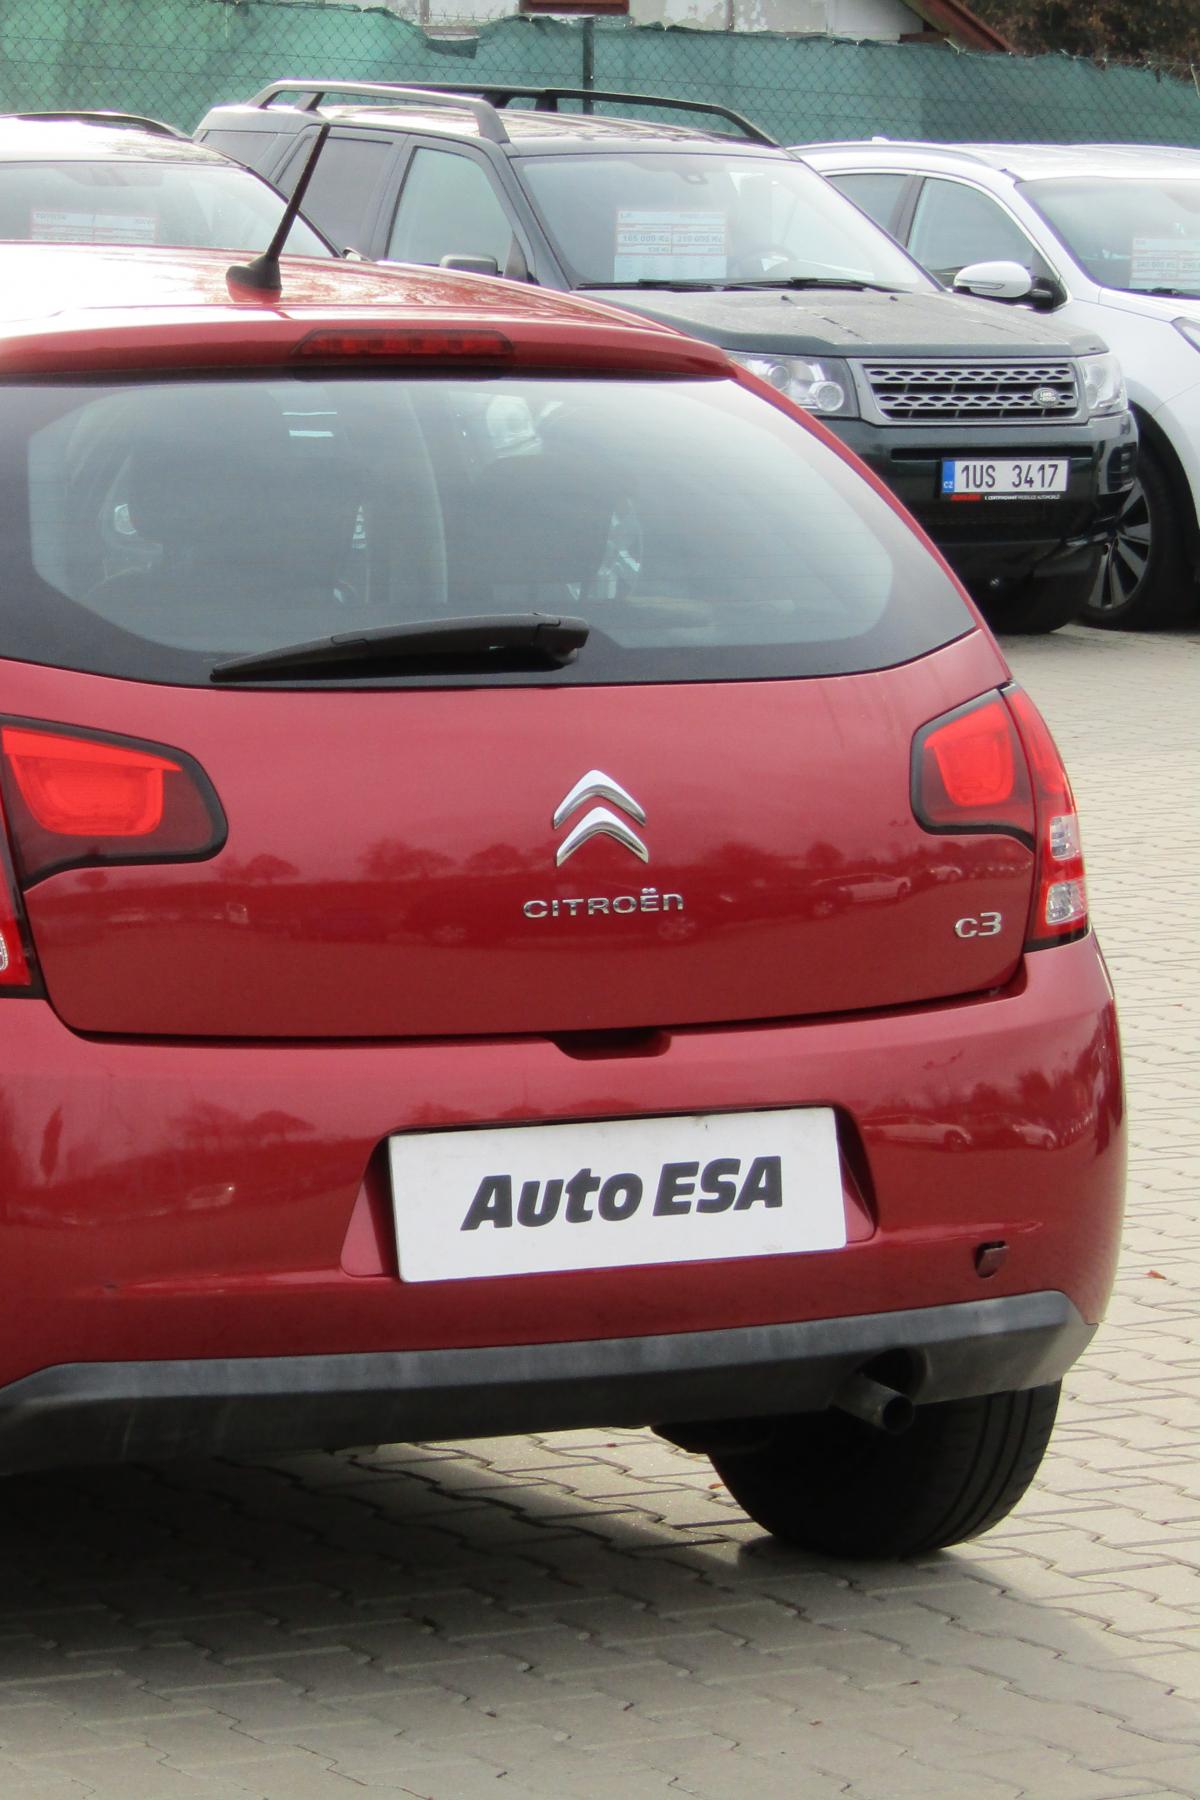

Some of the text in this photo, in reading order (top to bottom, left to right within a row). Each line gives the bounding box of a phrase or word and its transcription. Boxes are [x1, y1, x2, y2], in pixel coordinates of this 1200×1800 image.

[943, 481, 953, 489] CZ
[961, 464, 1059, 489] 1US 3417
[954, 911, 1002, 938] C3
[460, 1155, 783, 1232] Auto ESA
